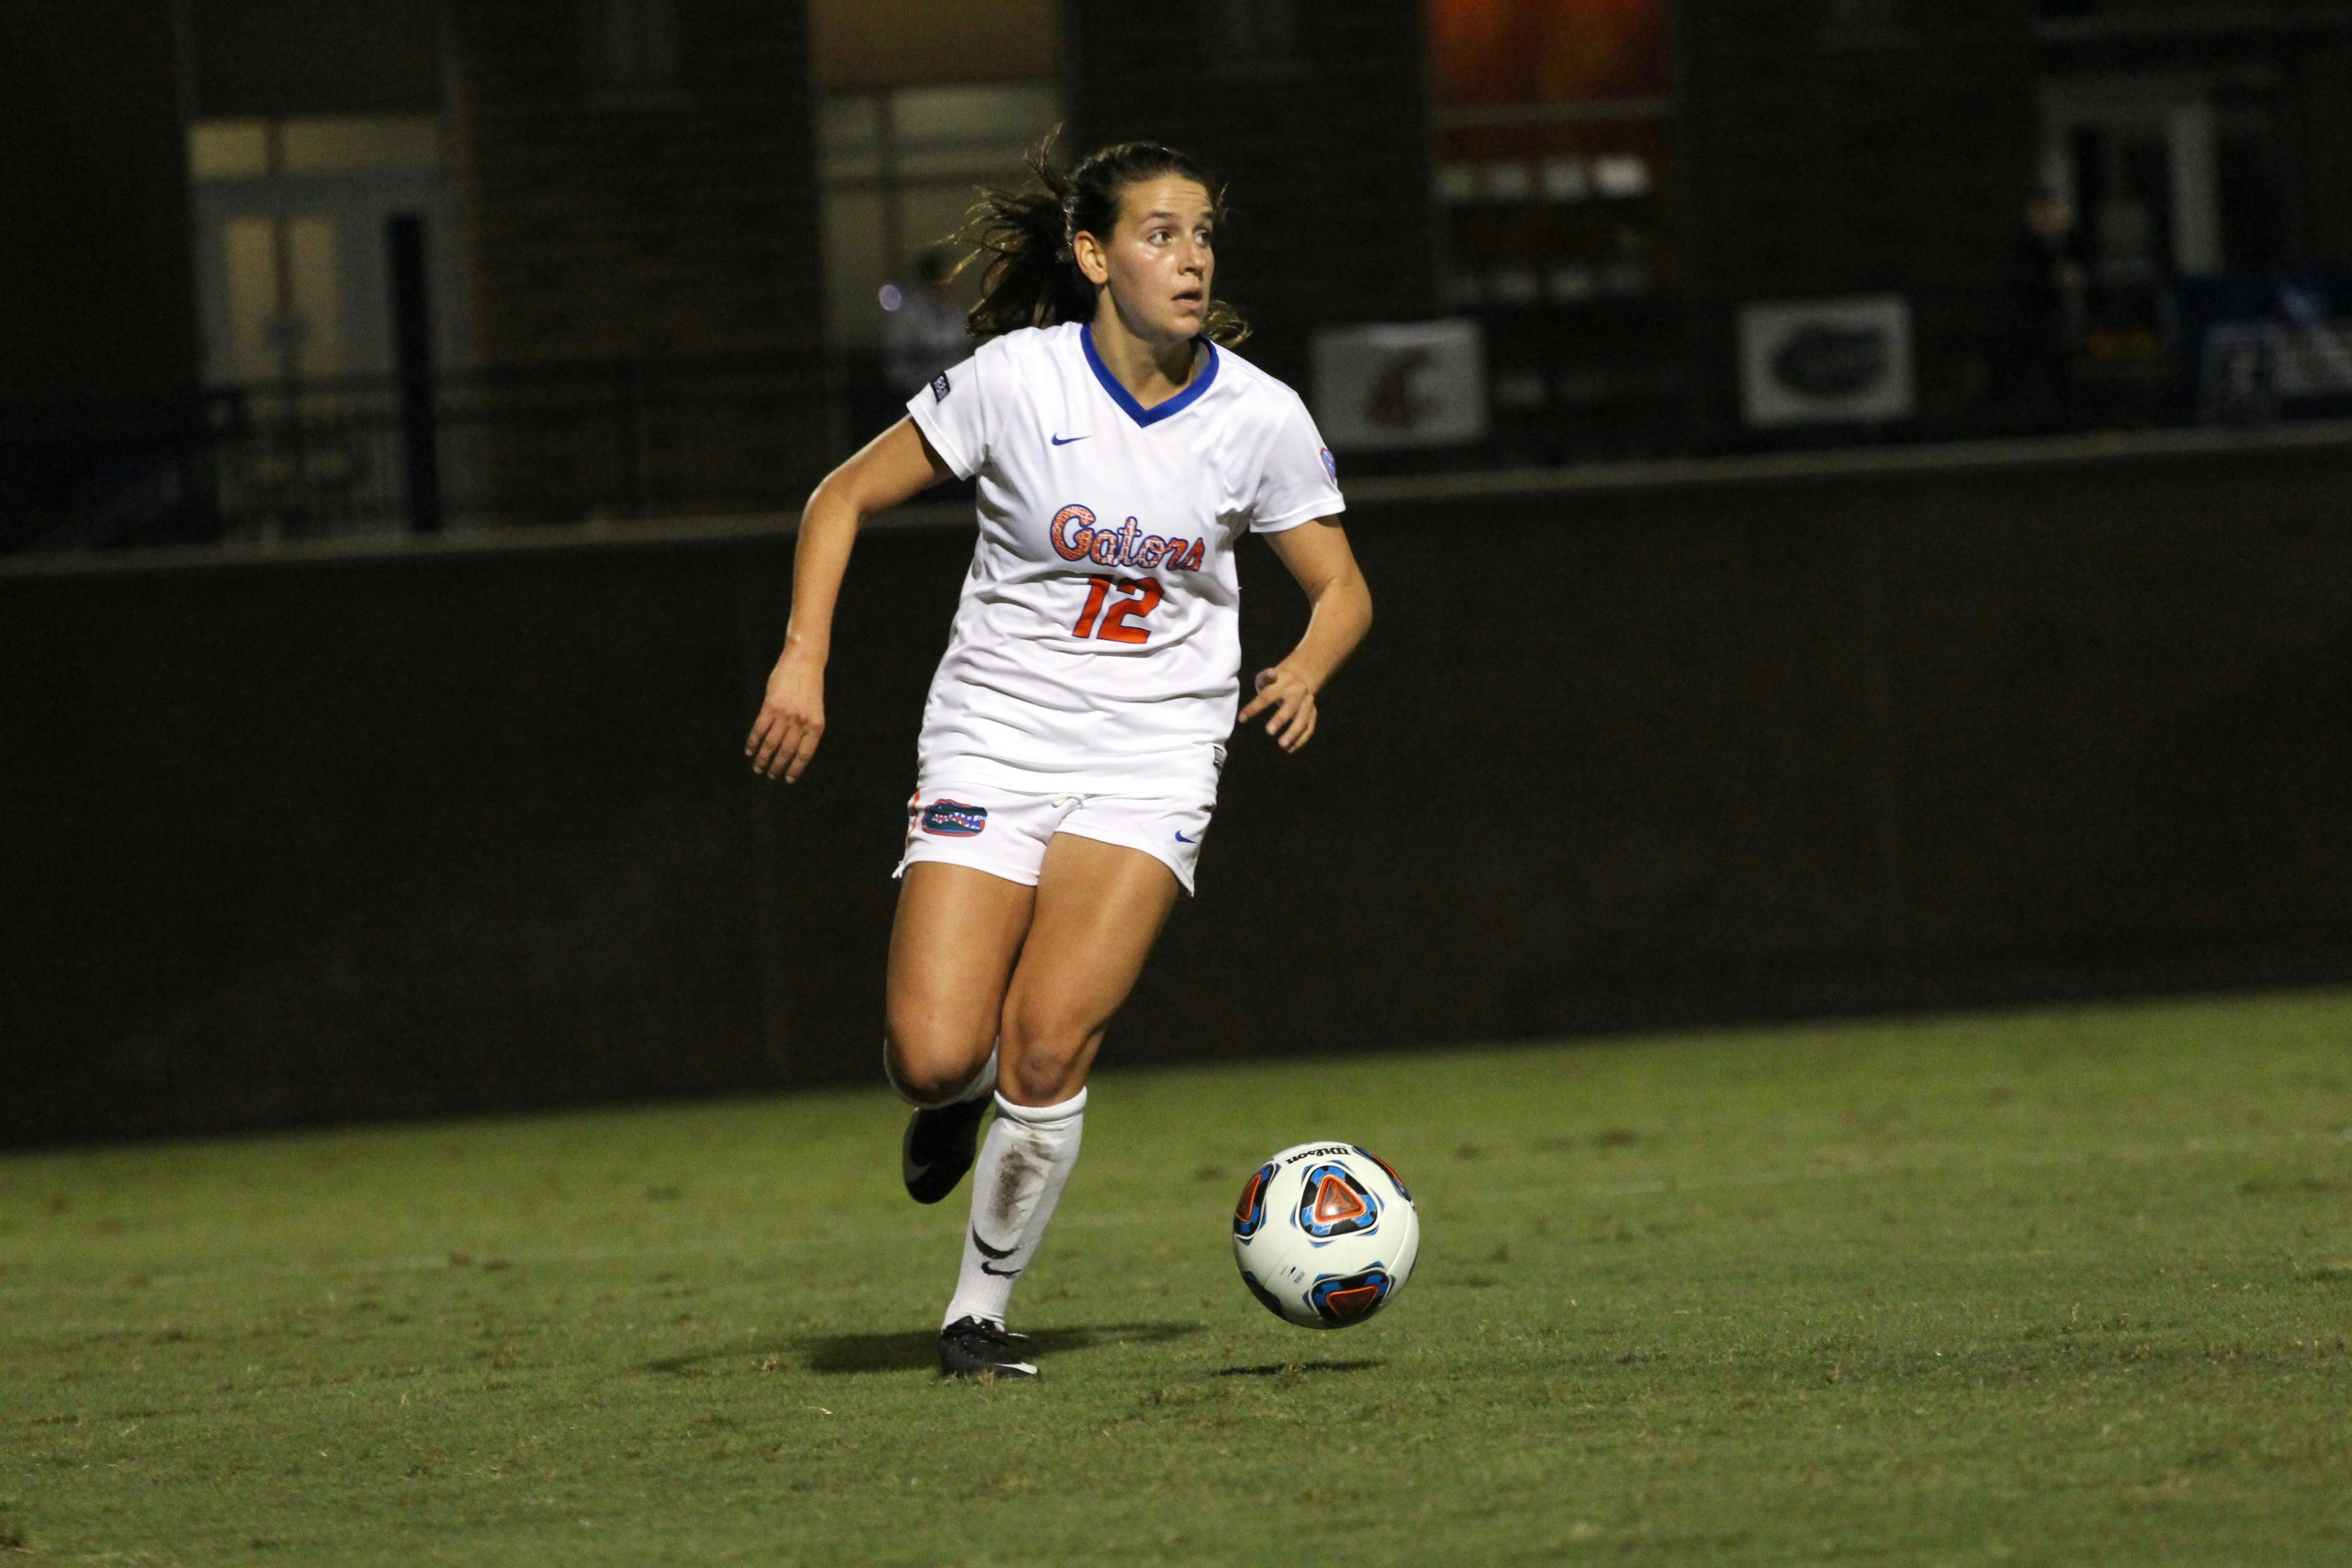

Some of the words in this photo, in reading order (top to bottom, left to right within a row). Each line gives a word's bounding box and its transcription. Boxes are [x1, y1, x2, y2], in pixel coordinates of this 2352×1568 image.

[1050, 504, 1205, 572] Gators
[1072, 574, 1165, 643] 12
[1285, 1147, 1351, 1164] Wilson
